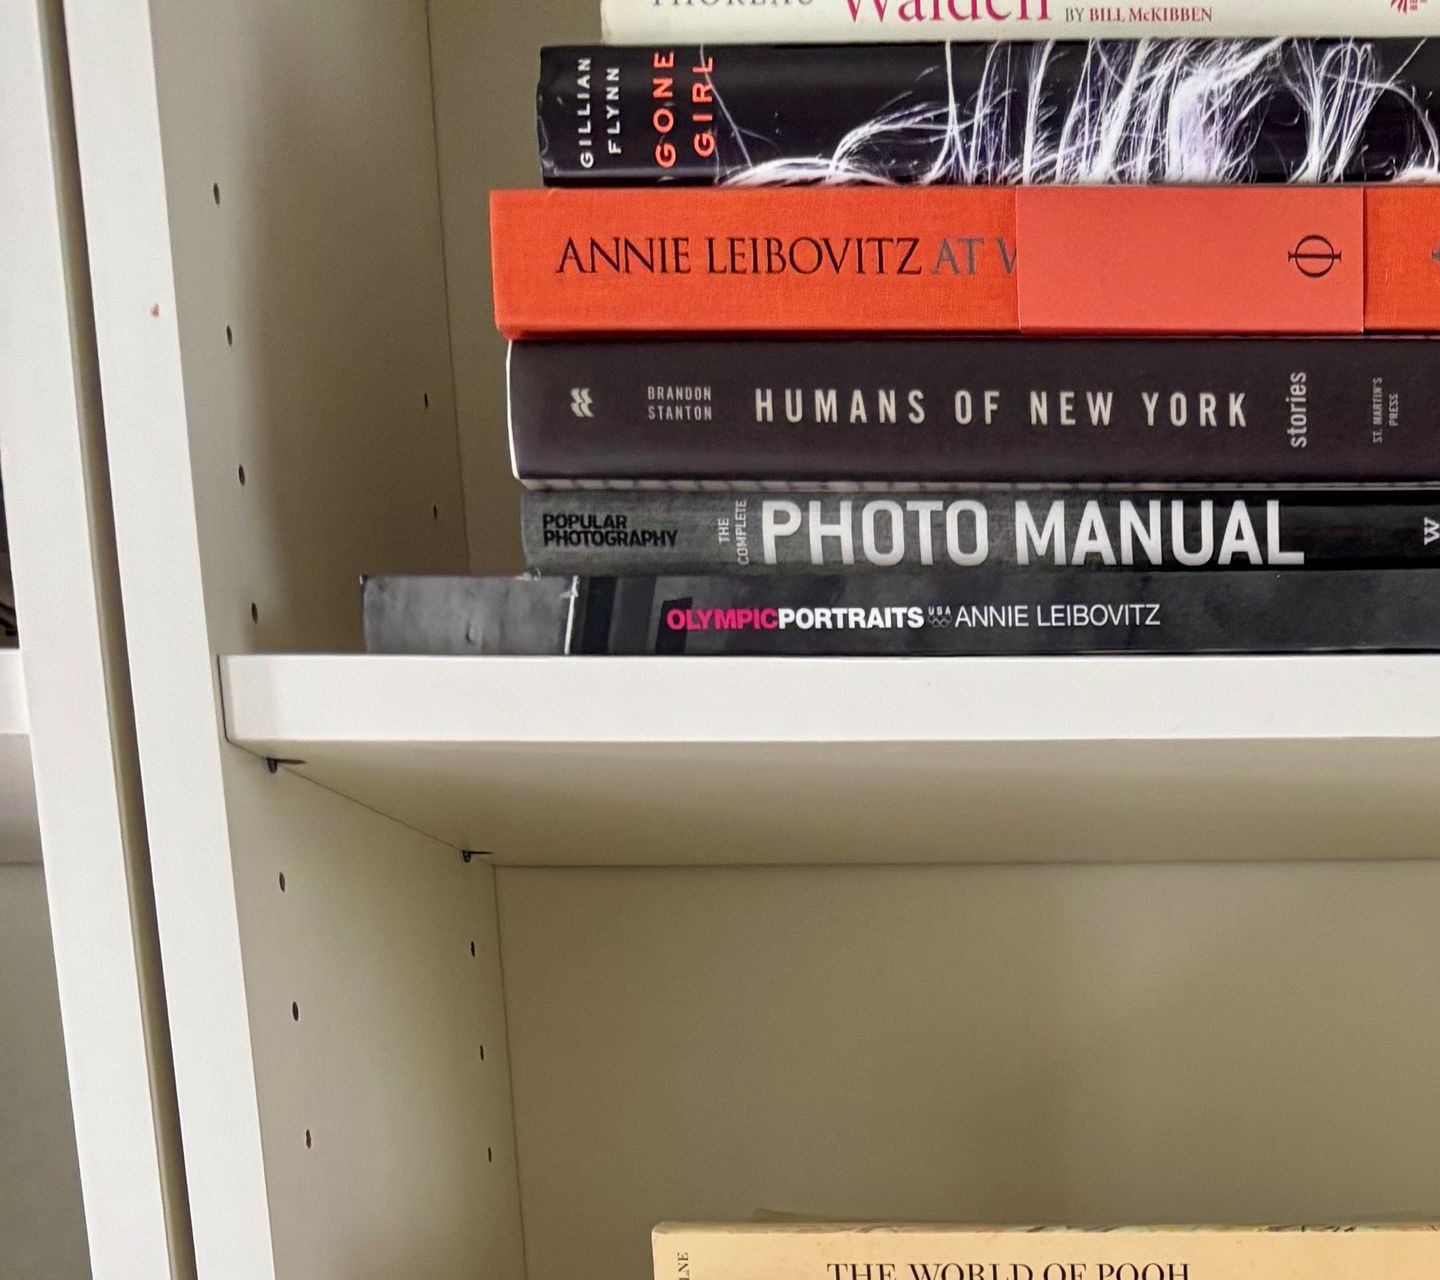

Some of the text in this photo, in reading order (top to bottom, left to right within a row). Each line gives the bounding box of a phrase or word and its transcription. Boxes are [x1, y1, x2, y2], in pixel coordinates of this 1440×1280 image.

[1065, 7, 1213, 22] BY BILL McKIBBEN
[579, 57, 594, 168] GILLIAN
[606, 67, 621, 154] FLYNN
[653, 50, 676, 168] GONE
[692, 56, 715, 157] GIRL
[555, 236, 691, 275] ANNIE
[705, 237, 922, 275] LEIBOVITZ
[930, 236, 984, 276] AT
[647, 385, 712, 401] BRANDON
[755, 388, 1247, 427] HUMANS OF NEW YORK
[1290, 372, 1307, 448] stories
[1389, 393, 1398, 427] PRESS
[648, 405, 712, 421] STANTON
[543, 513, 627, 530] POPULAR
[543, 529, 678, 549] PHOTOGRAPHY
[718, 518, 730, 545] THE
[735, 499, 749, 565] COMPLETE
[762, 499, 1305, 567] PHOTO MANUAL
[955, 603, 1161, 629] ANNIE LEIBOVITZ
